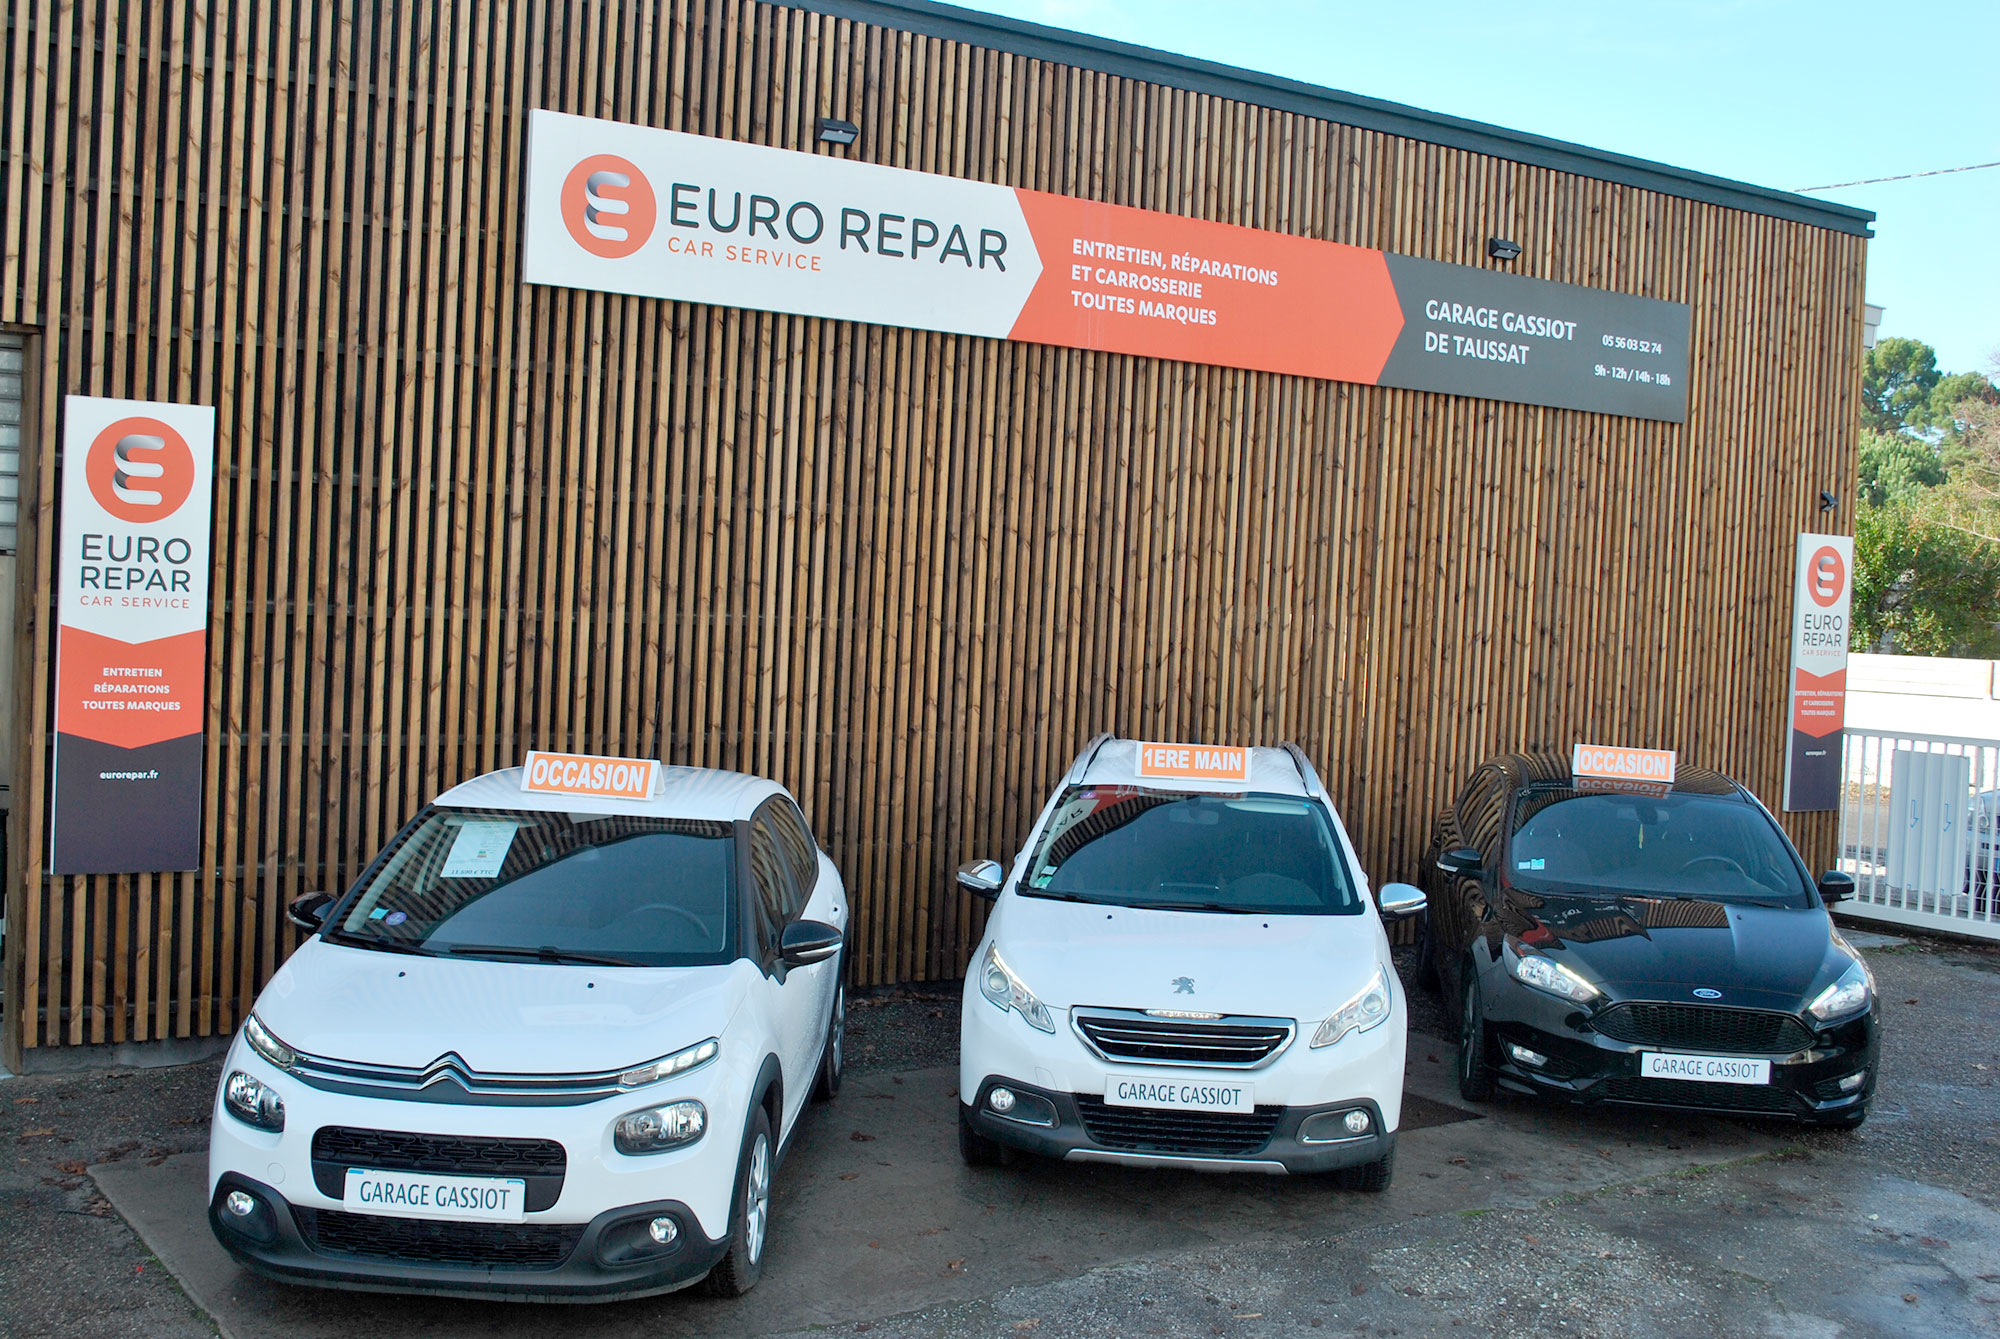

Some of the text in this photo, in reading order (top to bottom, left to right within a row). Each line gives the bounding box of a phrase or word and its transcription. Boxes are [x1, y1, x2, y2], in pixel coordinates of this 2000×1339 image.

[669, 182, 1008, 273] EURO REPAR
[667, 236, 822, 272] CAR SERVICE
[1073, 238, 1278, 287] ENTRETIEN, RÉPARATIONS
[1071, 264, 1202, 299] ET CARROSSERIE
[1071, 290, 1217, 325] TOUTES MARQUES
[1425, 300, 1577, 341] GARAGE GASSIOT
[1425, 331, 1530, 365] DE TAUSSAT
[1602, 334, 1614, 347] 05
[1615, 336, 1626, 349] 56
[1639, 340, 1650, 353] 52
[1651, 342, 1662, 355] 74
[1594, 364, 1606, 376] 9h
[1611, 366, 1627, 380] 12h
[82, 534, 192, 565] EURO
[80, 566, 191, 592] REPAR
[80, 595, 190, 609] CAR SERVICE
[1804, 614, 1842, 631] EURO
[1802, 632, 1842, 647] REPAR
[102, 667, 163, 677] ENTRETIEN
[93, 681, 170, 694] RÉPARATIONS
[82, 700, 181, 712] TOUTES MARQUES
[1144, 748, 1242, 771] 1ERE MAIN
[1580, 750, 1667, 776] OCCASION
[99, 769, 159, 780] eurorepar.fr
[531, 758, 646, 793] OCCASION
[1653, 1058, 1760, 1078] GARAGE GASSIOT
[1118, 1082, 1241, 1105] GARAGE GASSIOT
[360, 1181, 511, 1210] GARAGE GASSIOT
